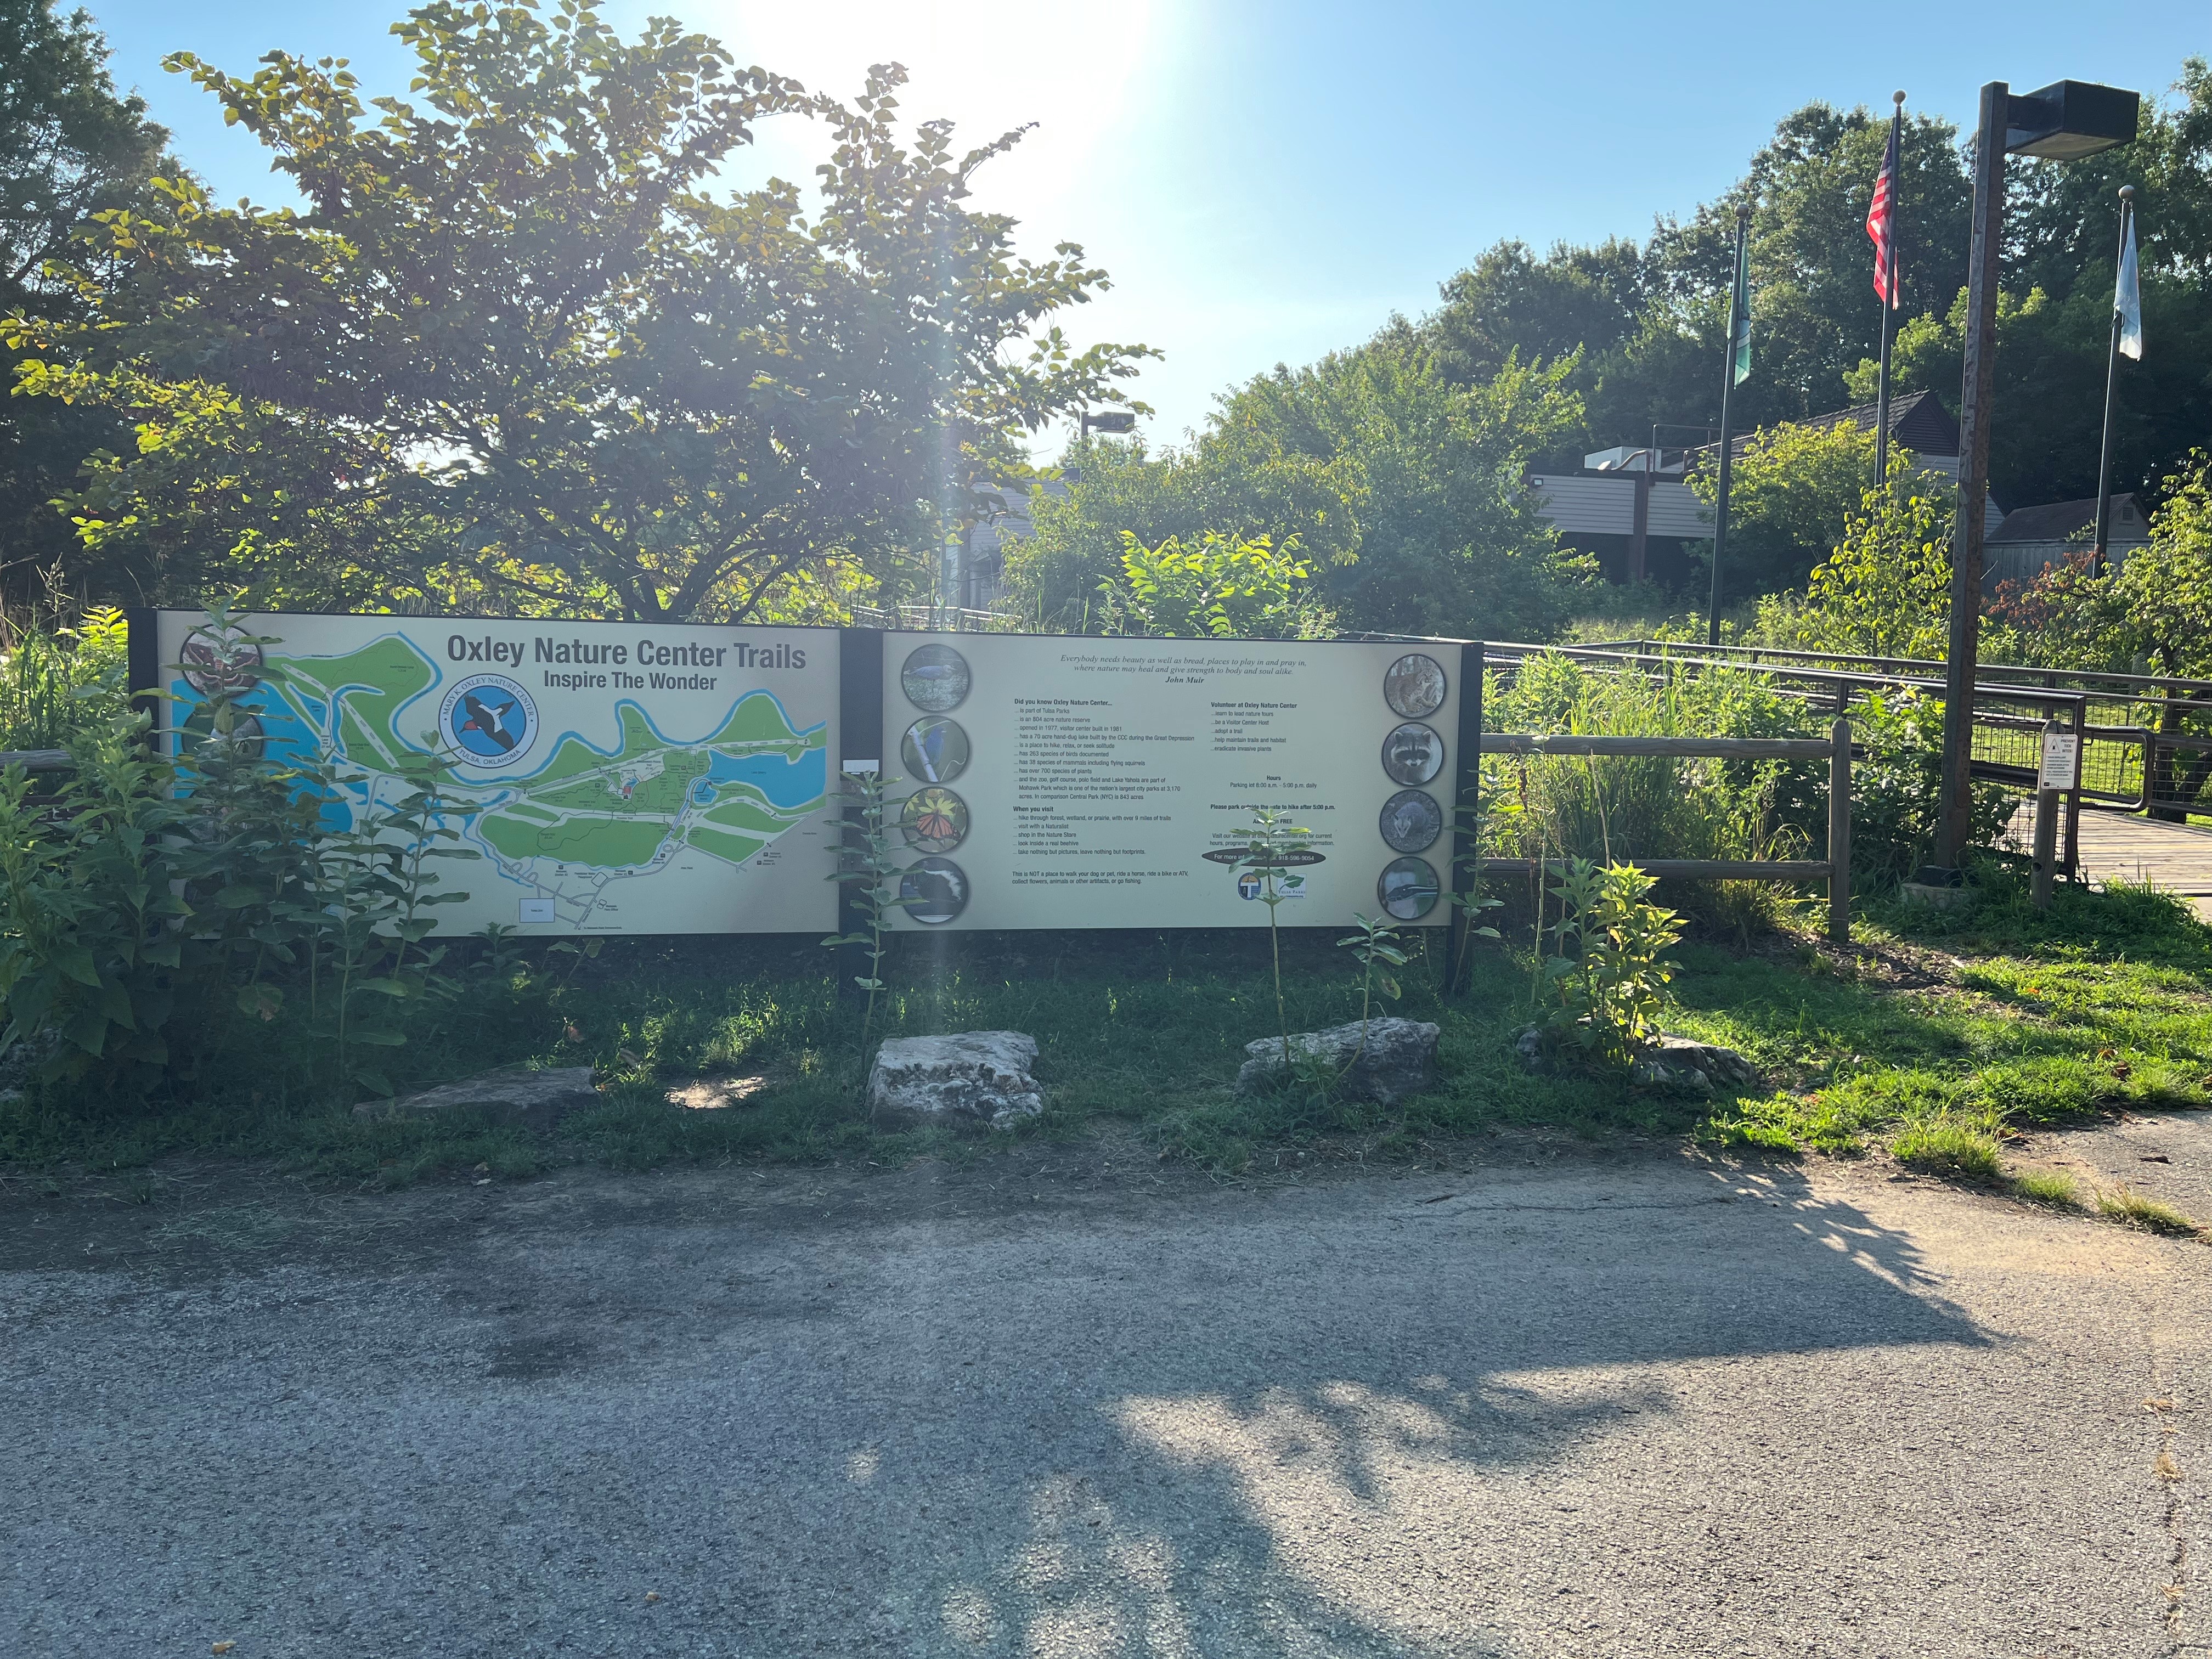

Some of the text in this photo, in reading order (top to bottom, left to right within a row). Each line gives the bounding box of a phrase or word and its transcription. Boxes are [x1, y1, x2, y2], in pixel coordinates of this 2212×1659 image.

[448, 635, 805, 669] Oxley Nature Center Trails
[1061, 654, 1098, 663] Everybody
[1122, 656, 1146, 664] beauty
[1207, 657, 1229, 666] places
[1240, 658, 1255, 667] play
[1187, 666, 1215, 675] strength
[1226, 667, 1242, 675] body
[545, 670, 717, 691] Inspire The Wonder
[443, 696, 456, 715] MARY
[462, 677, 486, 690] OXLEY
[488, 677, 518, 692] NATURE
[516, 690, 534, 716] CENTER
[483, 749, 521, 764] OKLAHOMA
